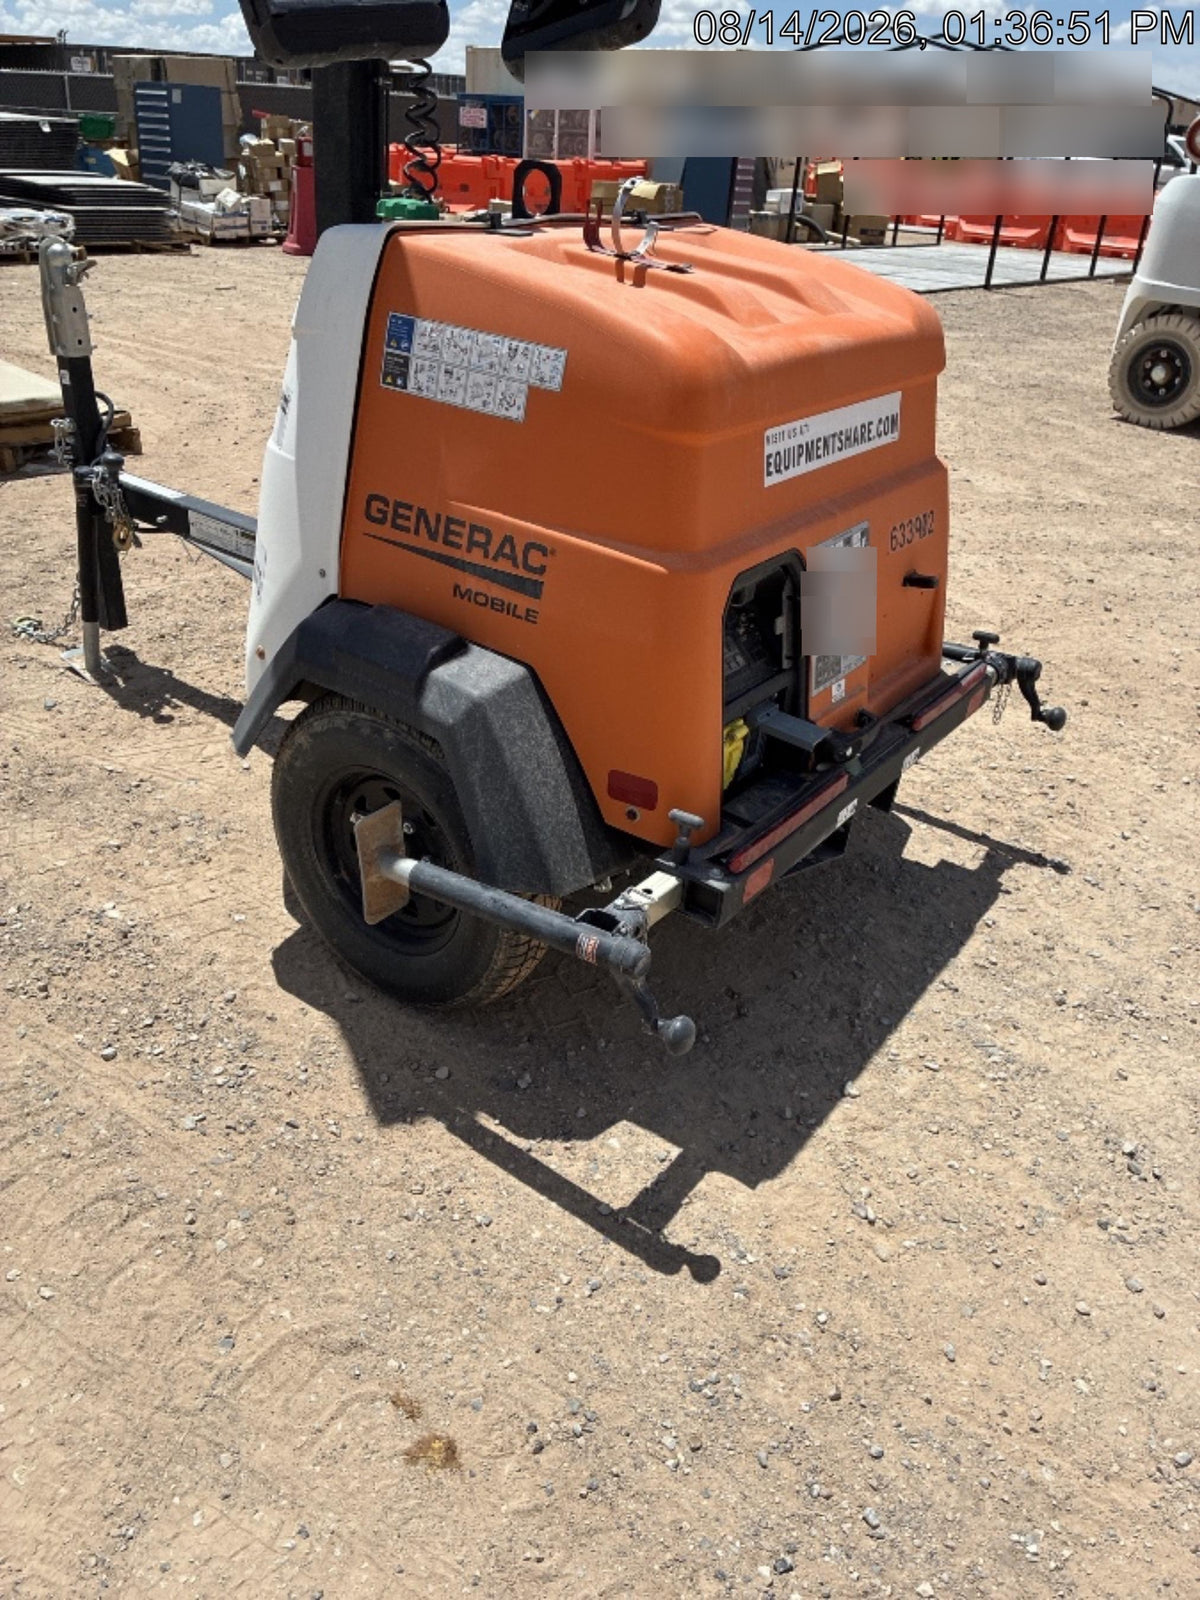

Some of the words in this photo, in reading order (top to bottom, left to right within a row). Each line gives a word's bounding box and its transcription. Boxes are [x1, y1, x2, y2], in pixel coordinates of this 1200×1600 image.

[766, 412, 899, 477] EQUIPMENTSHARE.COM
[365, 493, 549, 575] GENERAC
[453, 583, 540, 625] MOBILE
